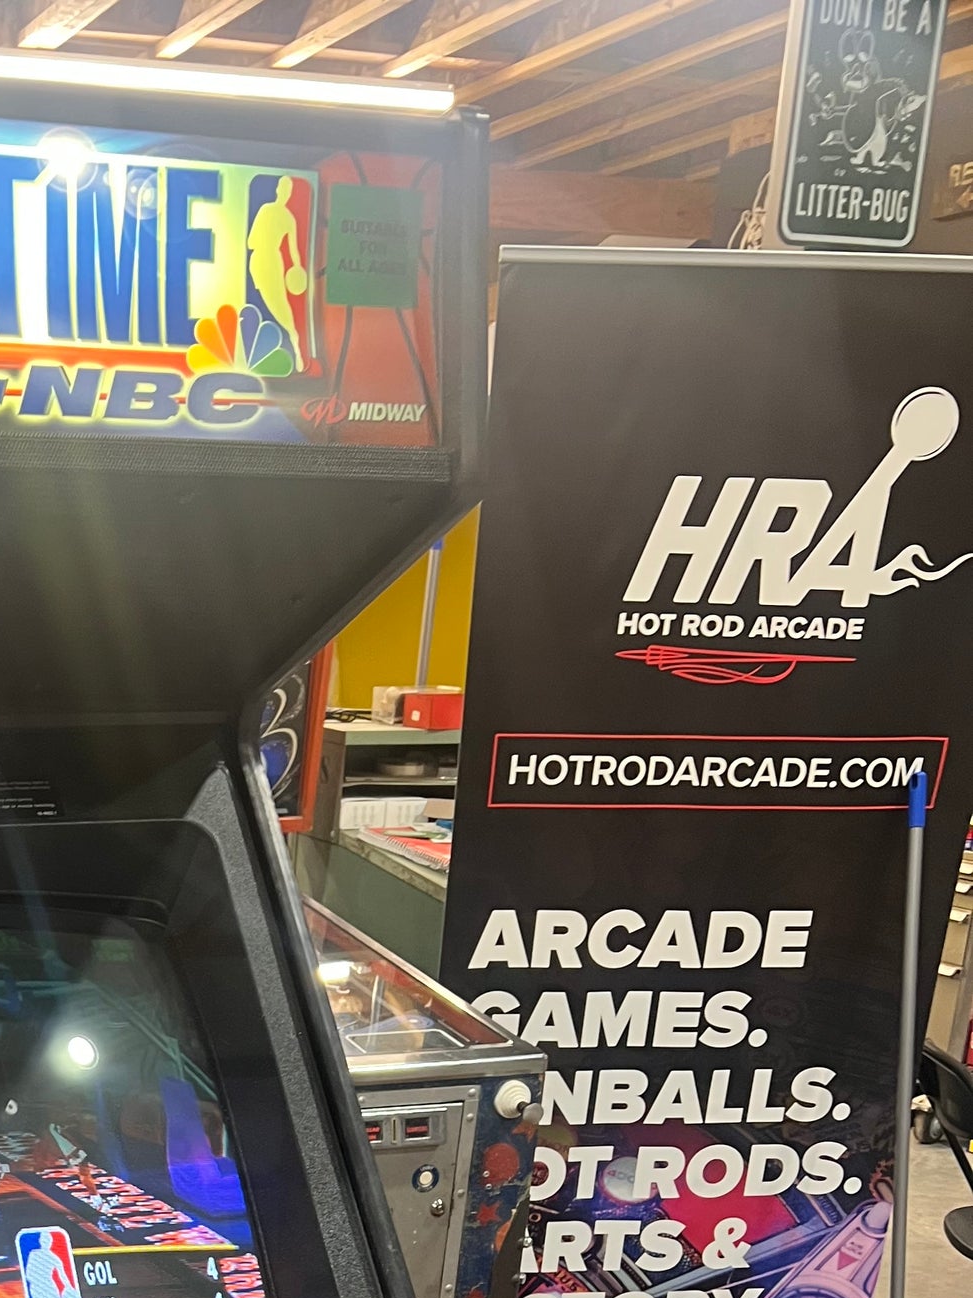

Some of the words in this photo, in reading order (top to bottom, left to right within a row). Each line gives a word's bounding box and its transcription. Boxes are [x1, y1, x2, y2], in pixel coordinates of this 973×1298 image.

[883, 0, 909, 33] BE
[915, 0, 933, 36] A
[795, 183, 912, 224] LITTER-BUG
[17, 364, 267, 425] NBC
[347, 401, 426, 422] MIDWAY
[616, 612, 677, 636] HOT
[680, 614, 745, 638] ROD
[748, 615, 866, 641] ARCADE
[508, 754, 924, 789] HOTRODARCADE.COM
[468, 909, 814, 969] ARCADE
[539, 1067, 852, 1126] NBALLS.
[530, 1144, 614, 1202] OT
[633, 1141, 863, 1200] RODS.
[520, 1219, 687, 1273] ARTS
[702, 1216, 751, 1270] &
[83, 1260, 118, 1286] GOL
[207, 1256, 218, 1281] 4
